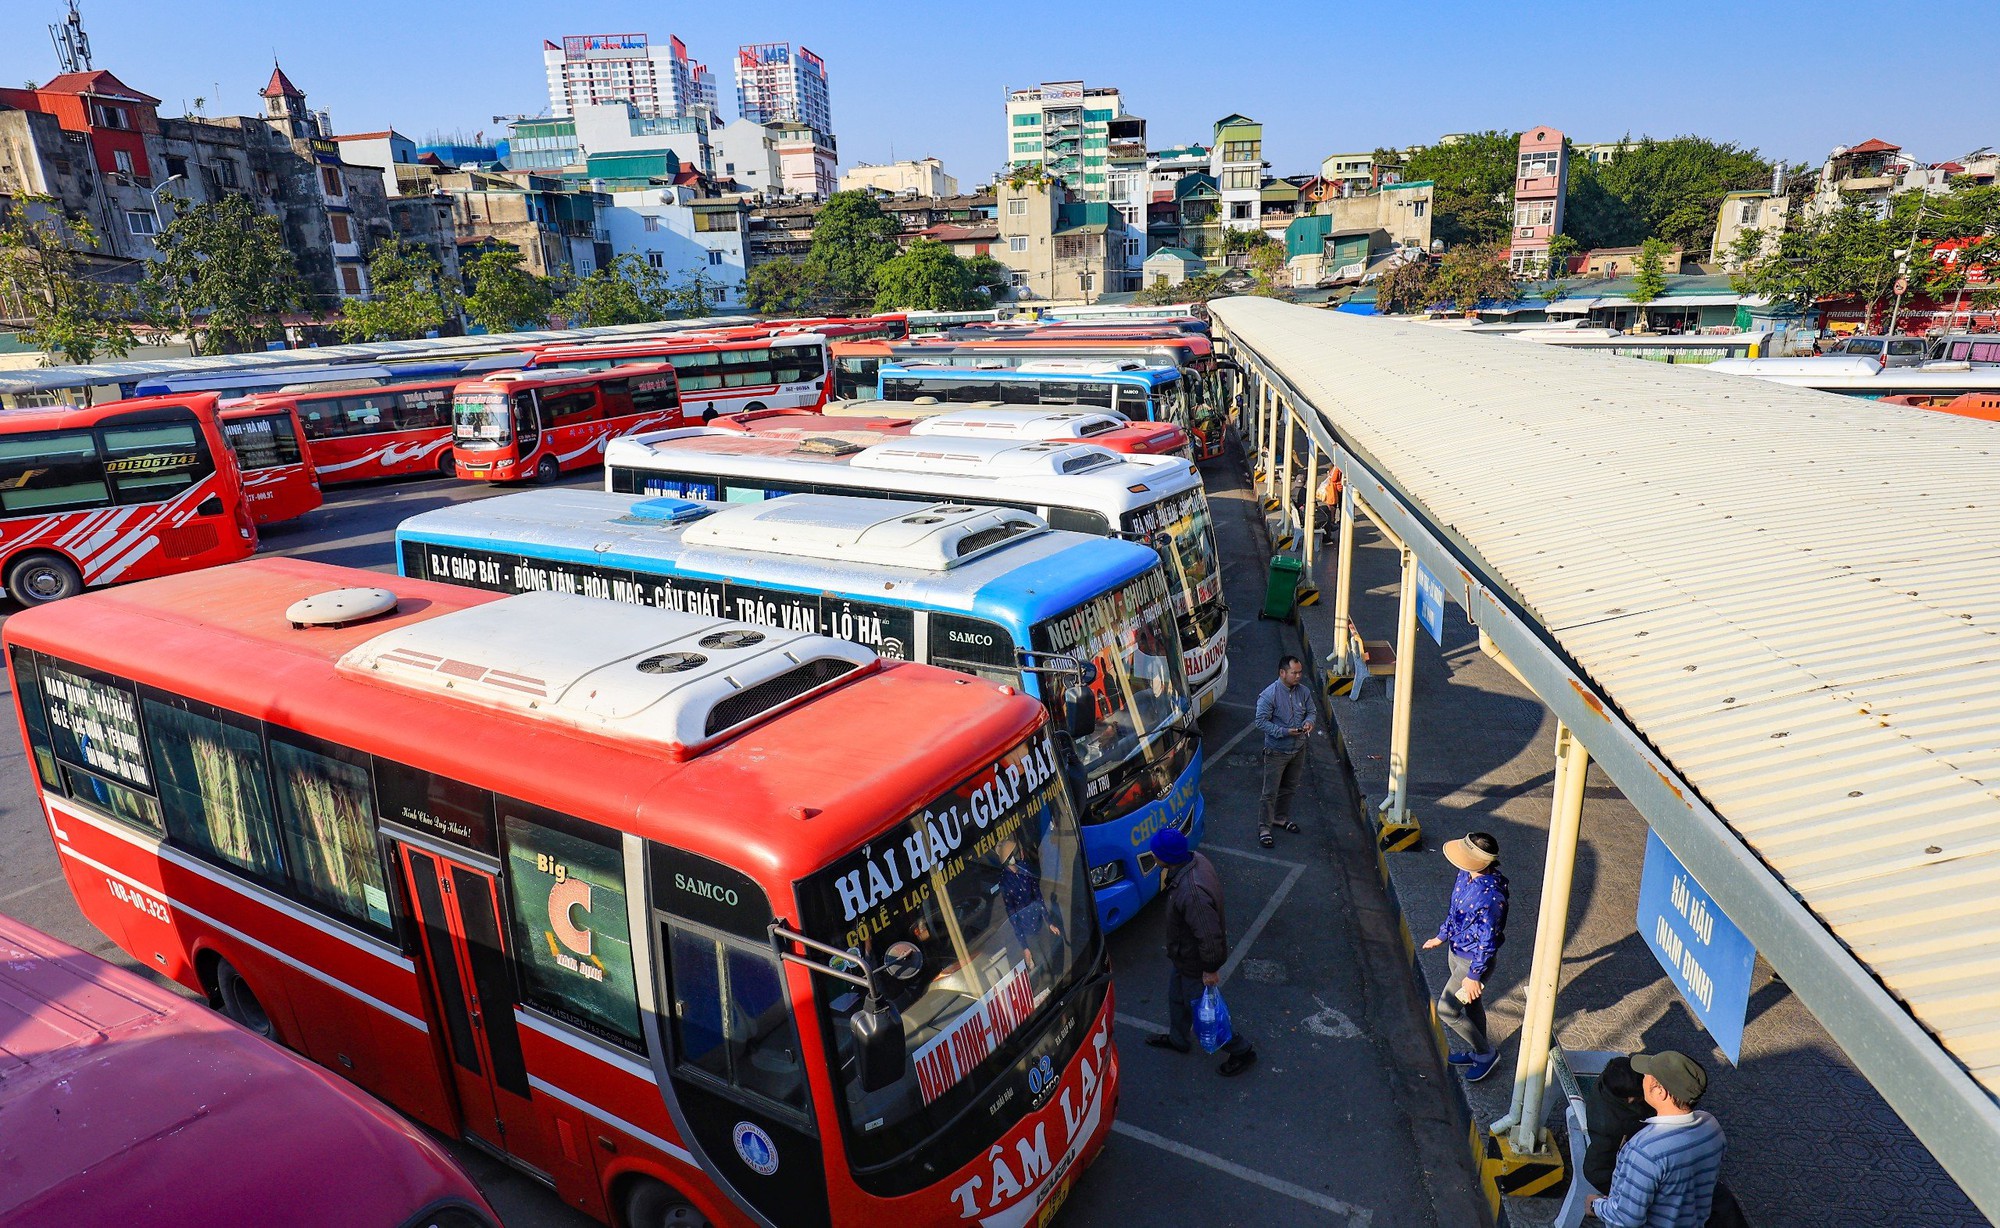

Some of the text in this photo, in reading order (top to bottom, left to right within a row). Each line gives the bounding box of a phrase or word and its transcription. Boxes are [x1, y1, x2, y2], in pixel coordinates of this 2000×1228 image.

[763, 48, 788, 63] MB
[107, 456, 196, 471] 0913067343
[431, 554, 450, 577] B.X
[451, 553, 476, 581] GIÁP
[479, 557, 500, 585] BÁT
[514, 558, 548, 591] ĐỒNG
[549, 567, 576, 594] VĂN
[583, 572, 610, 600] HÒA
[654, 579, 684, 612] CẦU
[687, 588, 719, 618] GIÁT
[736, 595, 778, 627] TRÁC
[781, 600, 815, 633] VĂN
[832, 602, 853, 641] LỖ
[858, 612, 883, 646] HÀ
[949, 630, 993, 646] SAMCO
[44, 676, 67, 700] NAM
[65, 683, 89, 708] ĐỊNH
[94, 688, 113, 716] HẢI
[835, 736, 1057, 921] HẢI HẬU GIÁP BÁT
[1130, 808, 1167, 847] CHÙA
[537, 853, 567, 883] Big
[872, 905, 891, 935] LỄ
[903, 883, 930, 914] LẠC
[974, 833, 997, 859] YÊN
[1027, 795, 1042, 820] HẢI
[106, 878, 170, 924] 18B-00.323
[675, 873, 739, 906] SAMCO
[548, 878, 591, 955] C
[1671, 874, 1714, 946] HẢI HẬU
[557, 953, 578, 972] NAM
[1656, 915, 1714, 1013] (NAM ĐỊNH)
[557, 1009, 587, 1029] ISUZU
[916, 1039, 957, 1108] NAM
[1028, 1055, 1054, 1094] 02
[950, 1121, 1052, 1218] TÂM
